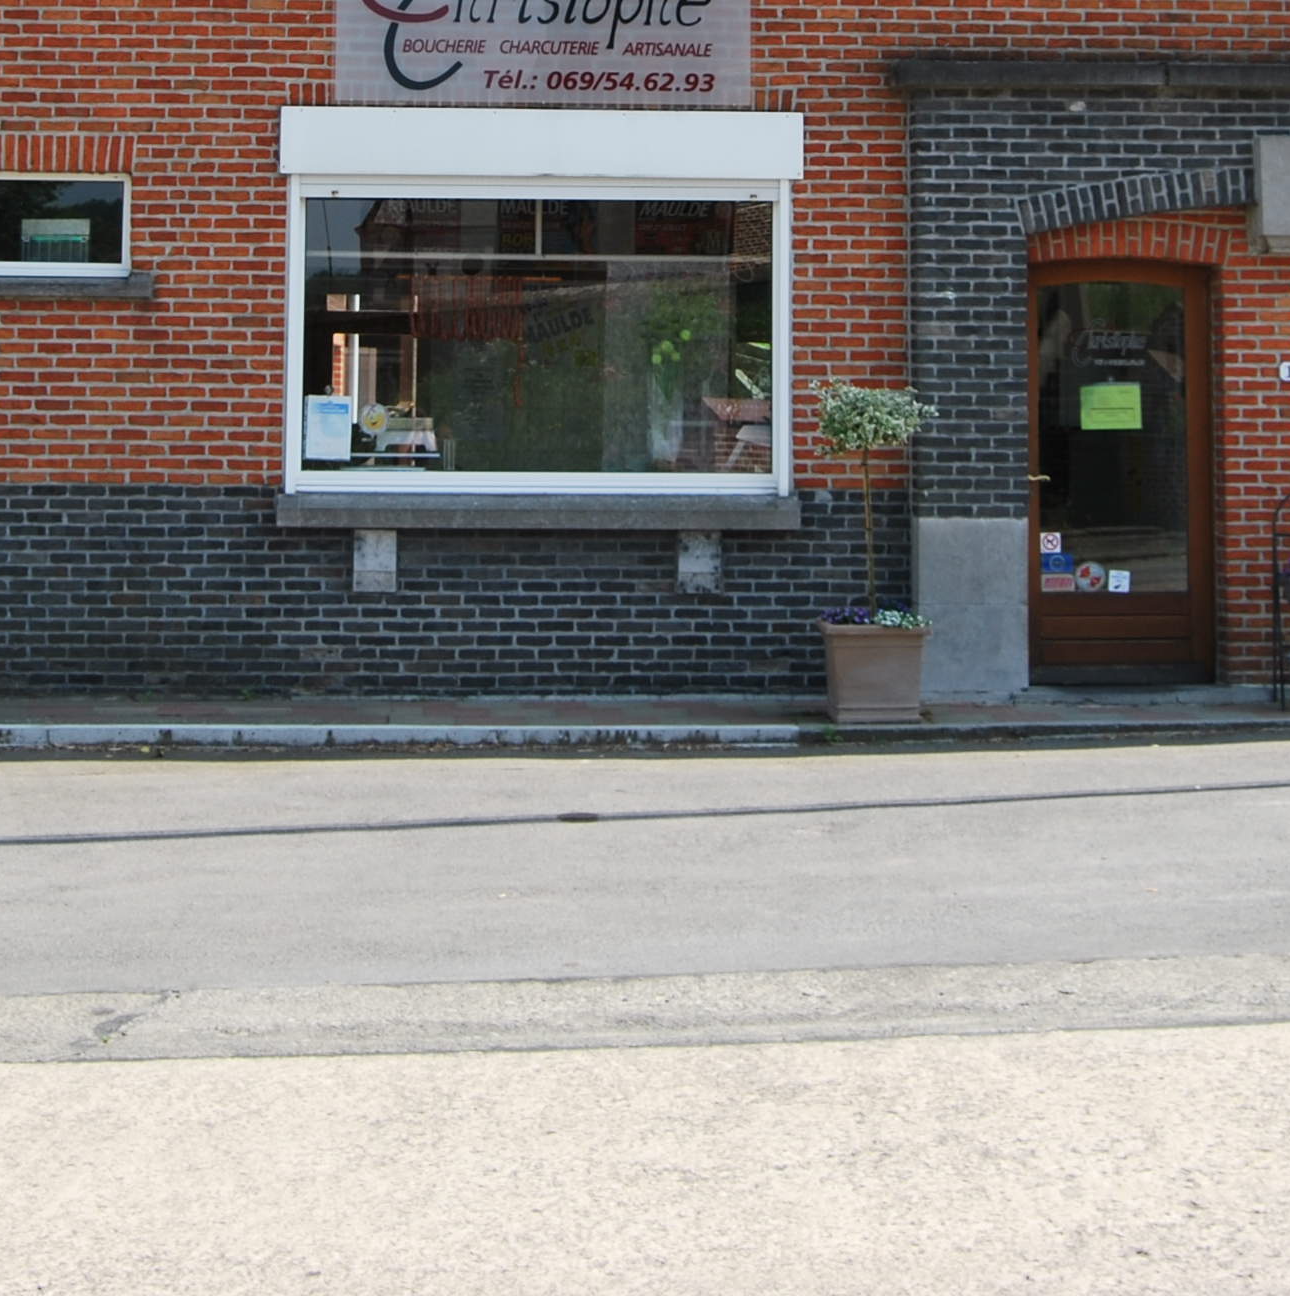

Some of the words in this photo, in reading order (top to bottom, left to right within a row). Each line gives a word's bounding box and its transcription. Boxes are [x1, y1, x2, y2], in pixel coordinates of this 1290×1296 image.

[402, 38, 486, 54] BOUCHERIE
[499, 39, 600, 56] CHARCUTERIE
[622, 41, 713, 58] ARTISANALE
[483, 68, 538, 90] Tél.:
[546, 70, 716, 93] 069/54.62.93
